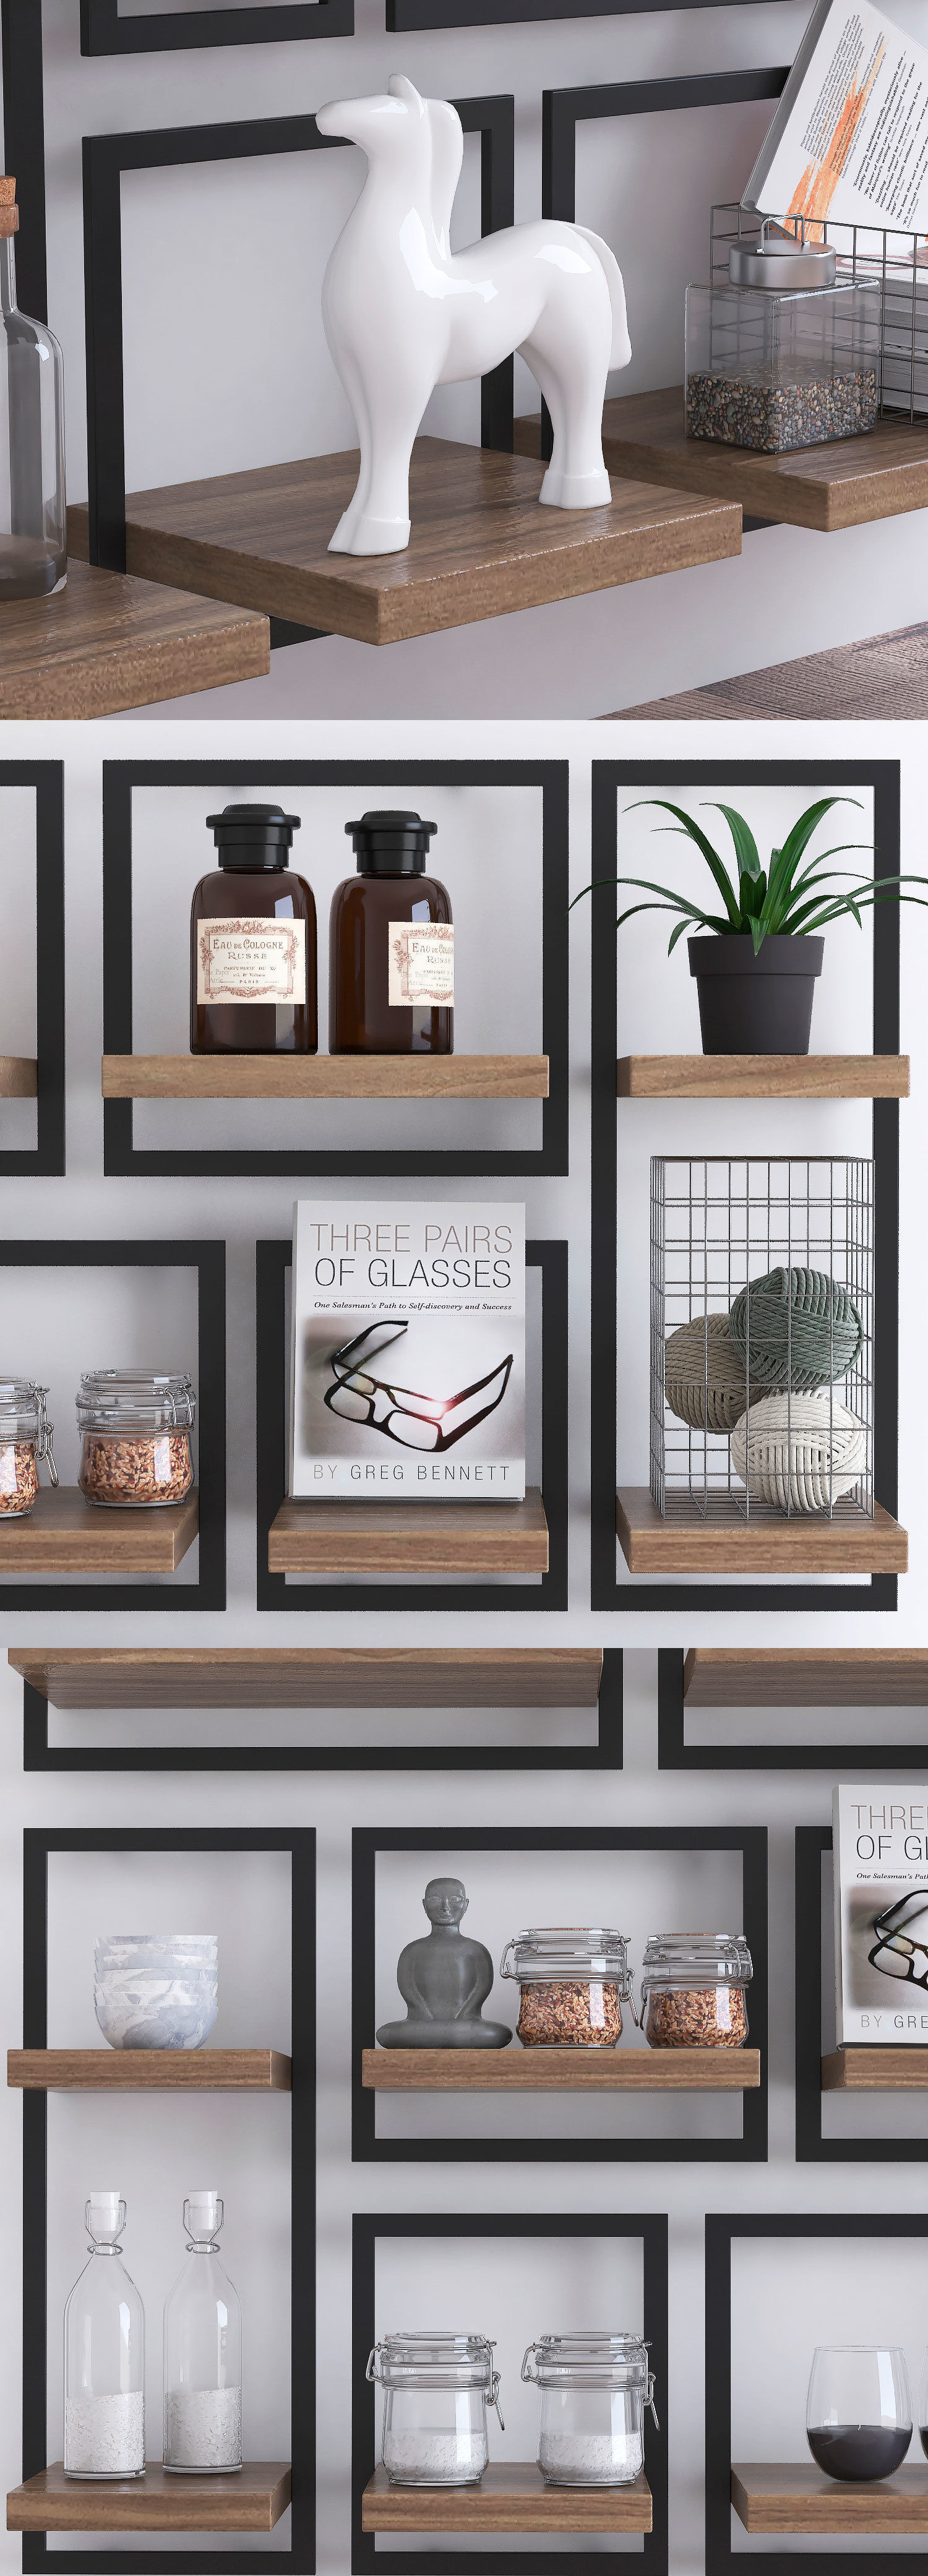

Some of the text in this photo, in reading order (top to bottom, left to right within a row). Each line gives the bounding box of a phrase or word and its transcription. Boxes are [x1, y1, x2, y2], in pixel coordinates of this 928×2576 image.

[866, 106, 886, 152] kaleidoscopically,
[884, 71, 898, 105] mysteriously
[876, 147, 884, 163] fiction
[893, 95, 903, 118] respond
[887, 153, 896, 173] should
[898, 122, 908, 144] required
[906, 101, 916, 121] reading
[858, 173, 866, 191] reality
[869, 141, 878, 161] fantasy
[896, 165, 905, 184] chaotic
[903, 139, 914, 163] brilliance
[885, 173, 895, 191] human
[213, 939, 232, 950] EAU
[243, 939, 283, 950] COLOGNE
[228, 952, 268, 960] RUSSE
[412, 943, 431, 953] EAU
[310, 1224, 512, 1253] THREE PAIRS
[315, 1258, 511, 1288] OF GLASSES
[408, 1302, 462, 1311] Self-discovery
[314, 1464, 510, 1480] BY GREG BENNETT
[851, 1805, 928, 1830] THRE
[856, 1835, 892, 1860] OF
[861, 2015, 882, 2028] BY
